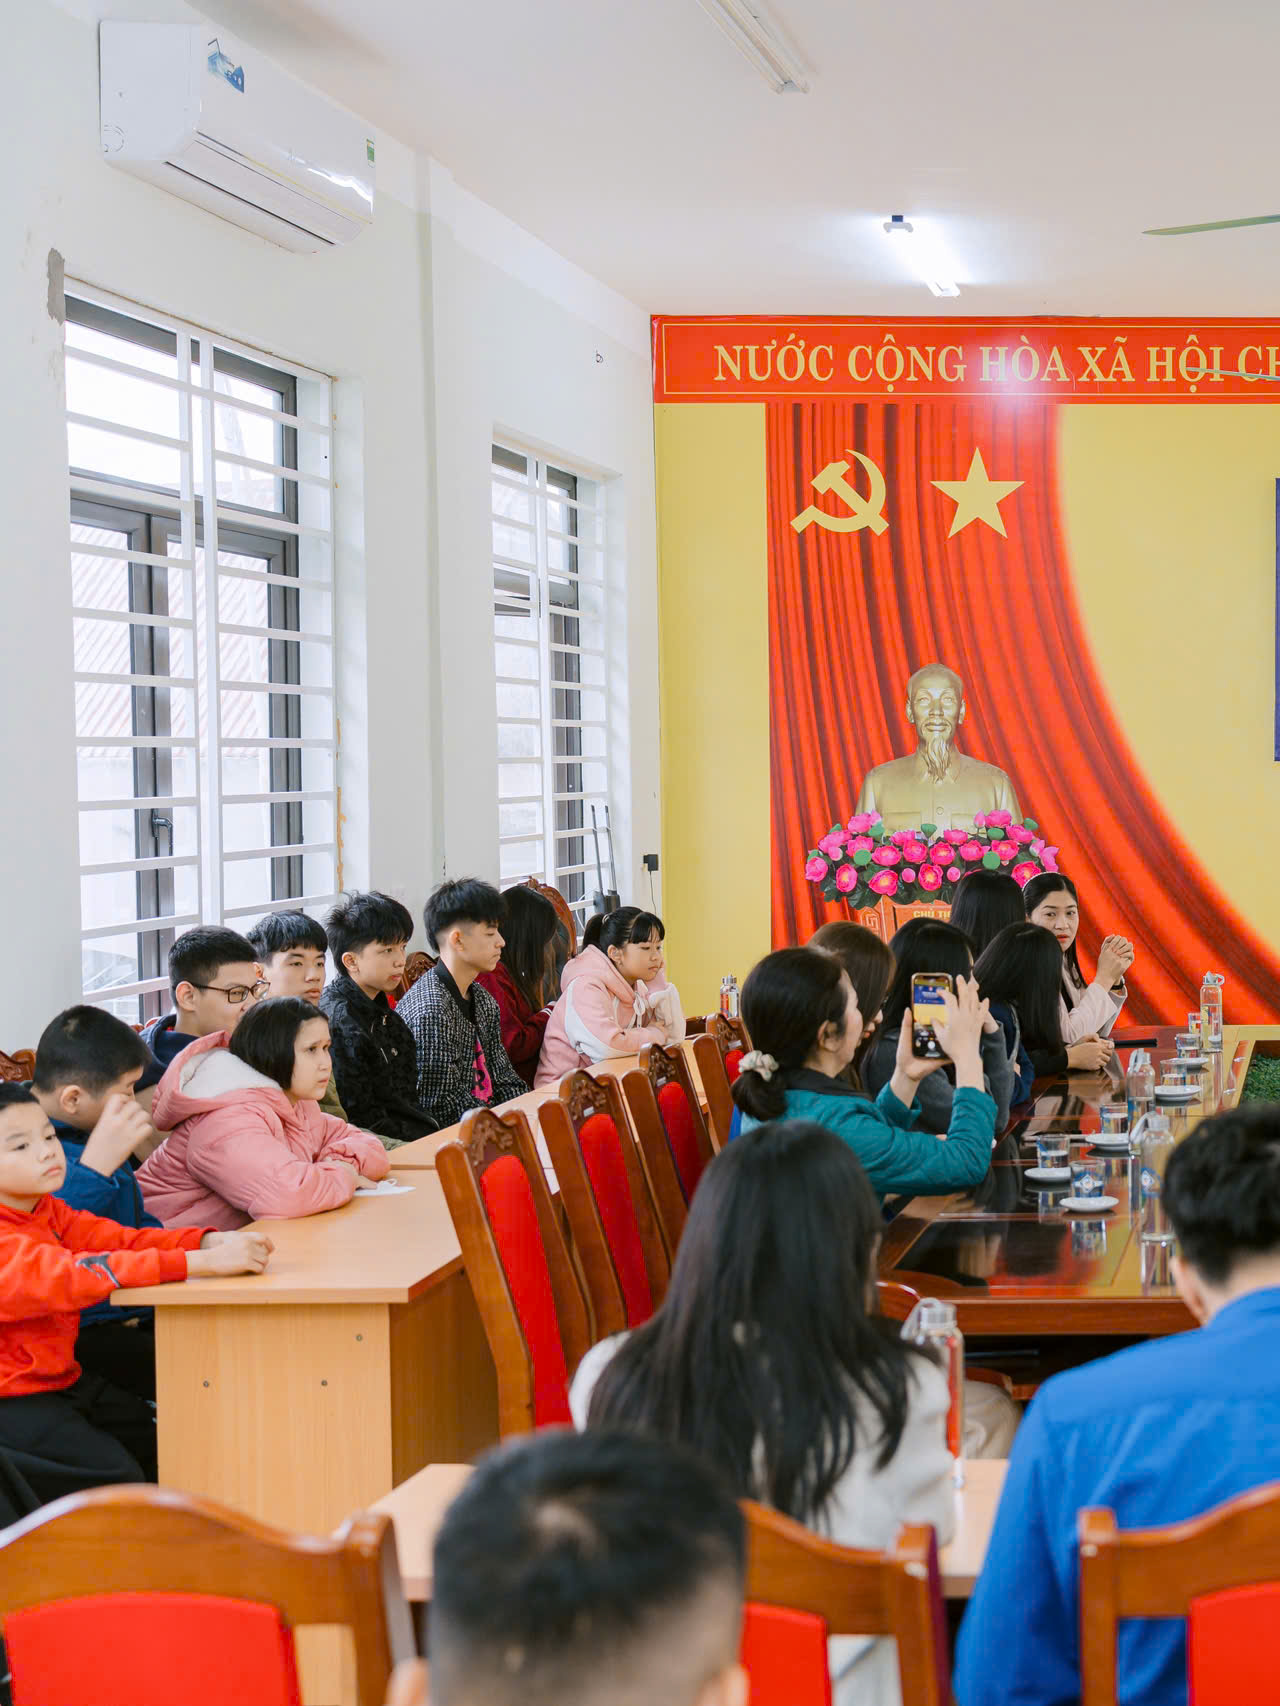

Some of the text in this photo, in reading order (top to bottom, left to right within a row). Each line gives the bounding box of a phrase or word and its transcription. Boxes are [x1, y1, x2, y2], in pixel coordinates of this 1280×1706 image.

[713, 332, 834, 382] NƯỚC
[847, 333, 967, 393] CỘNG
[979, 334, 1071, 383] HÒA
[1077, 335, 1136, 383] XÃ
[1146, 334, 1225, 393] HỘI
